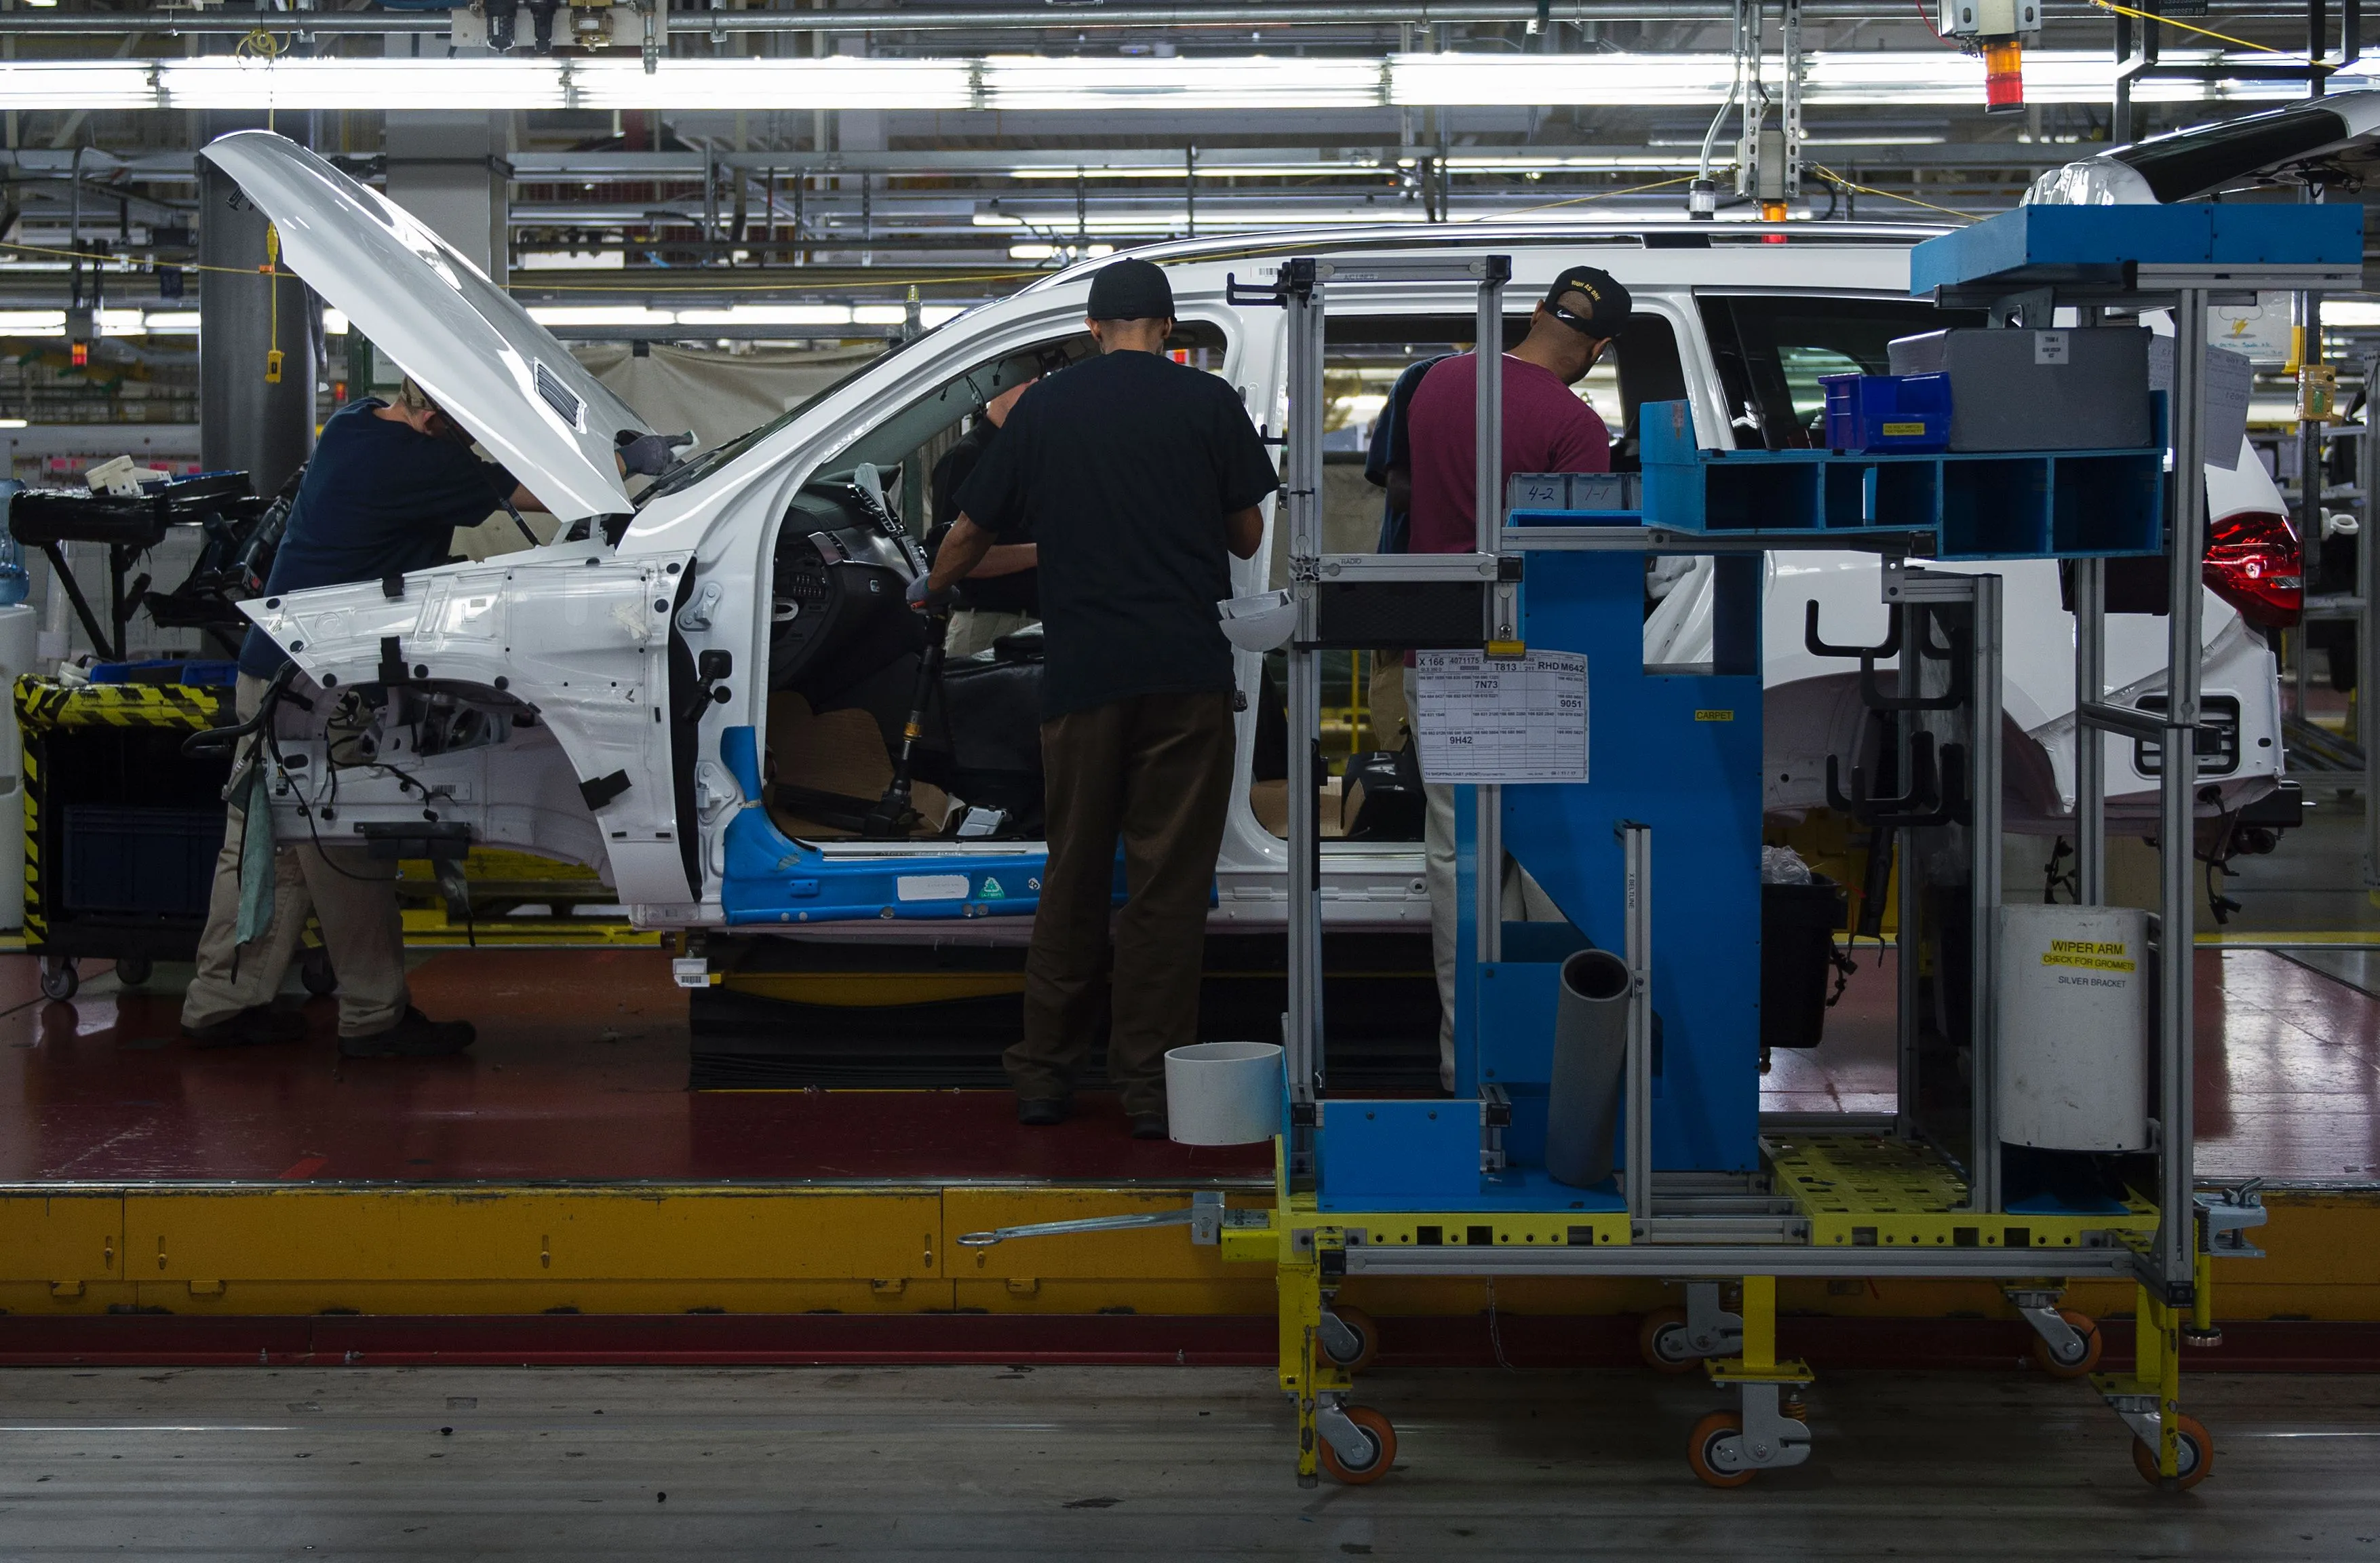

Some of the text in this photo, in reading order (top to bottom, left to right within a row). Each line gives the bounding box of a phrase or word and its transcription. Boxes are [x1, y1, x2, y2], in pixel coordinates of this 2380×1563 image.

[1584, 284, 1593, 292] AS
[1591, 290, 1601, 302] ONE
[1529, 485, 1555, 501] 4-2
[1419, 658, 1444, 666] X 166
[1538, 661, 1559, 670] RHD
[1494, 663, 1517, 672] T813
[1561, 663, 1584, 673] M642
[1475, 680, 1498, 689] 7N73
[1560, 700, 1582, 708] 9051
[1696, 711, 1732, 720] CARPET
[1449, 737, 1472, 745] 9H42
[2052, 941, 2123, 954] WIPER ARM
[2043, 954, 2135, 971] CHECK FOR GROMMETS
[2058, 976, 2126, 988] SILVER BRACKET
